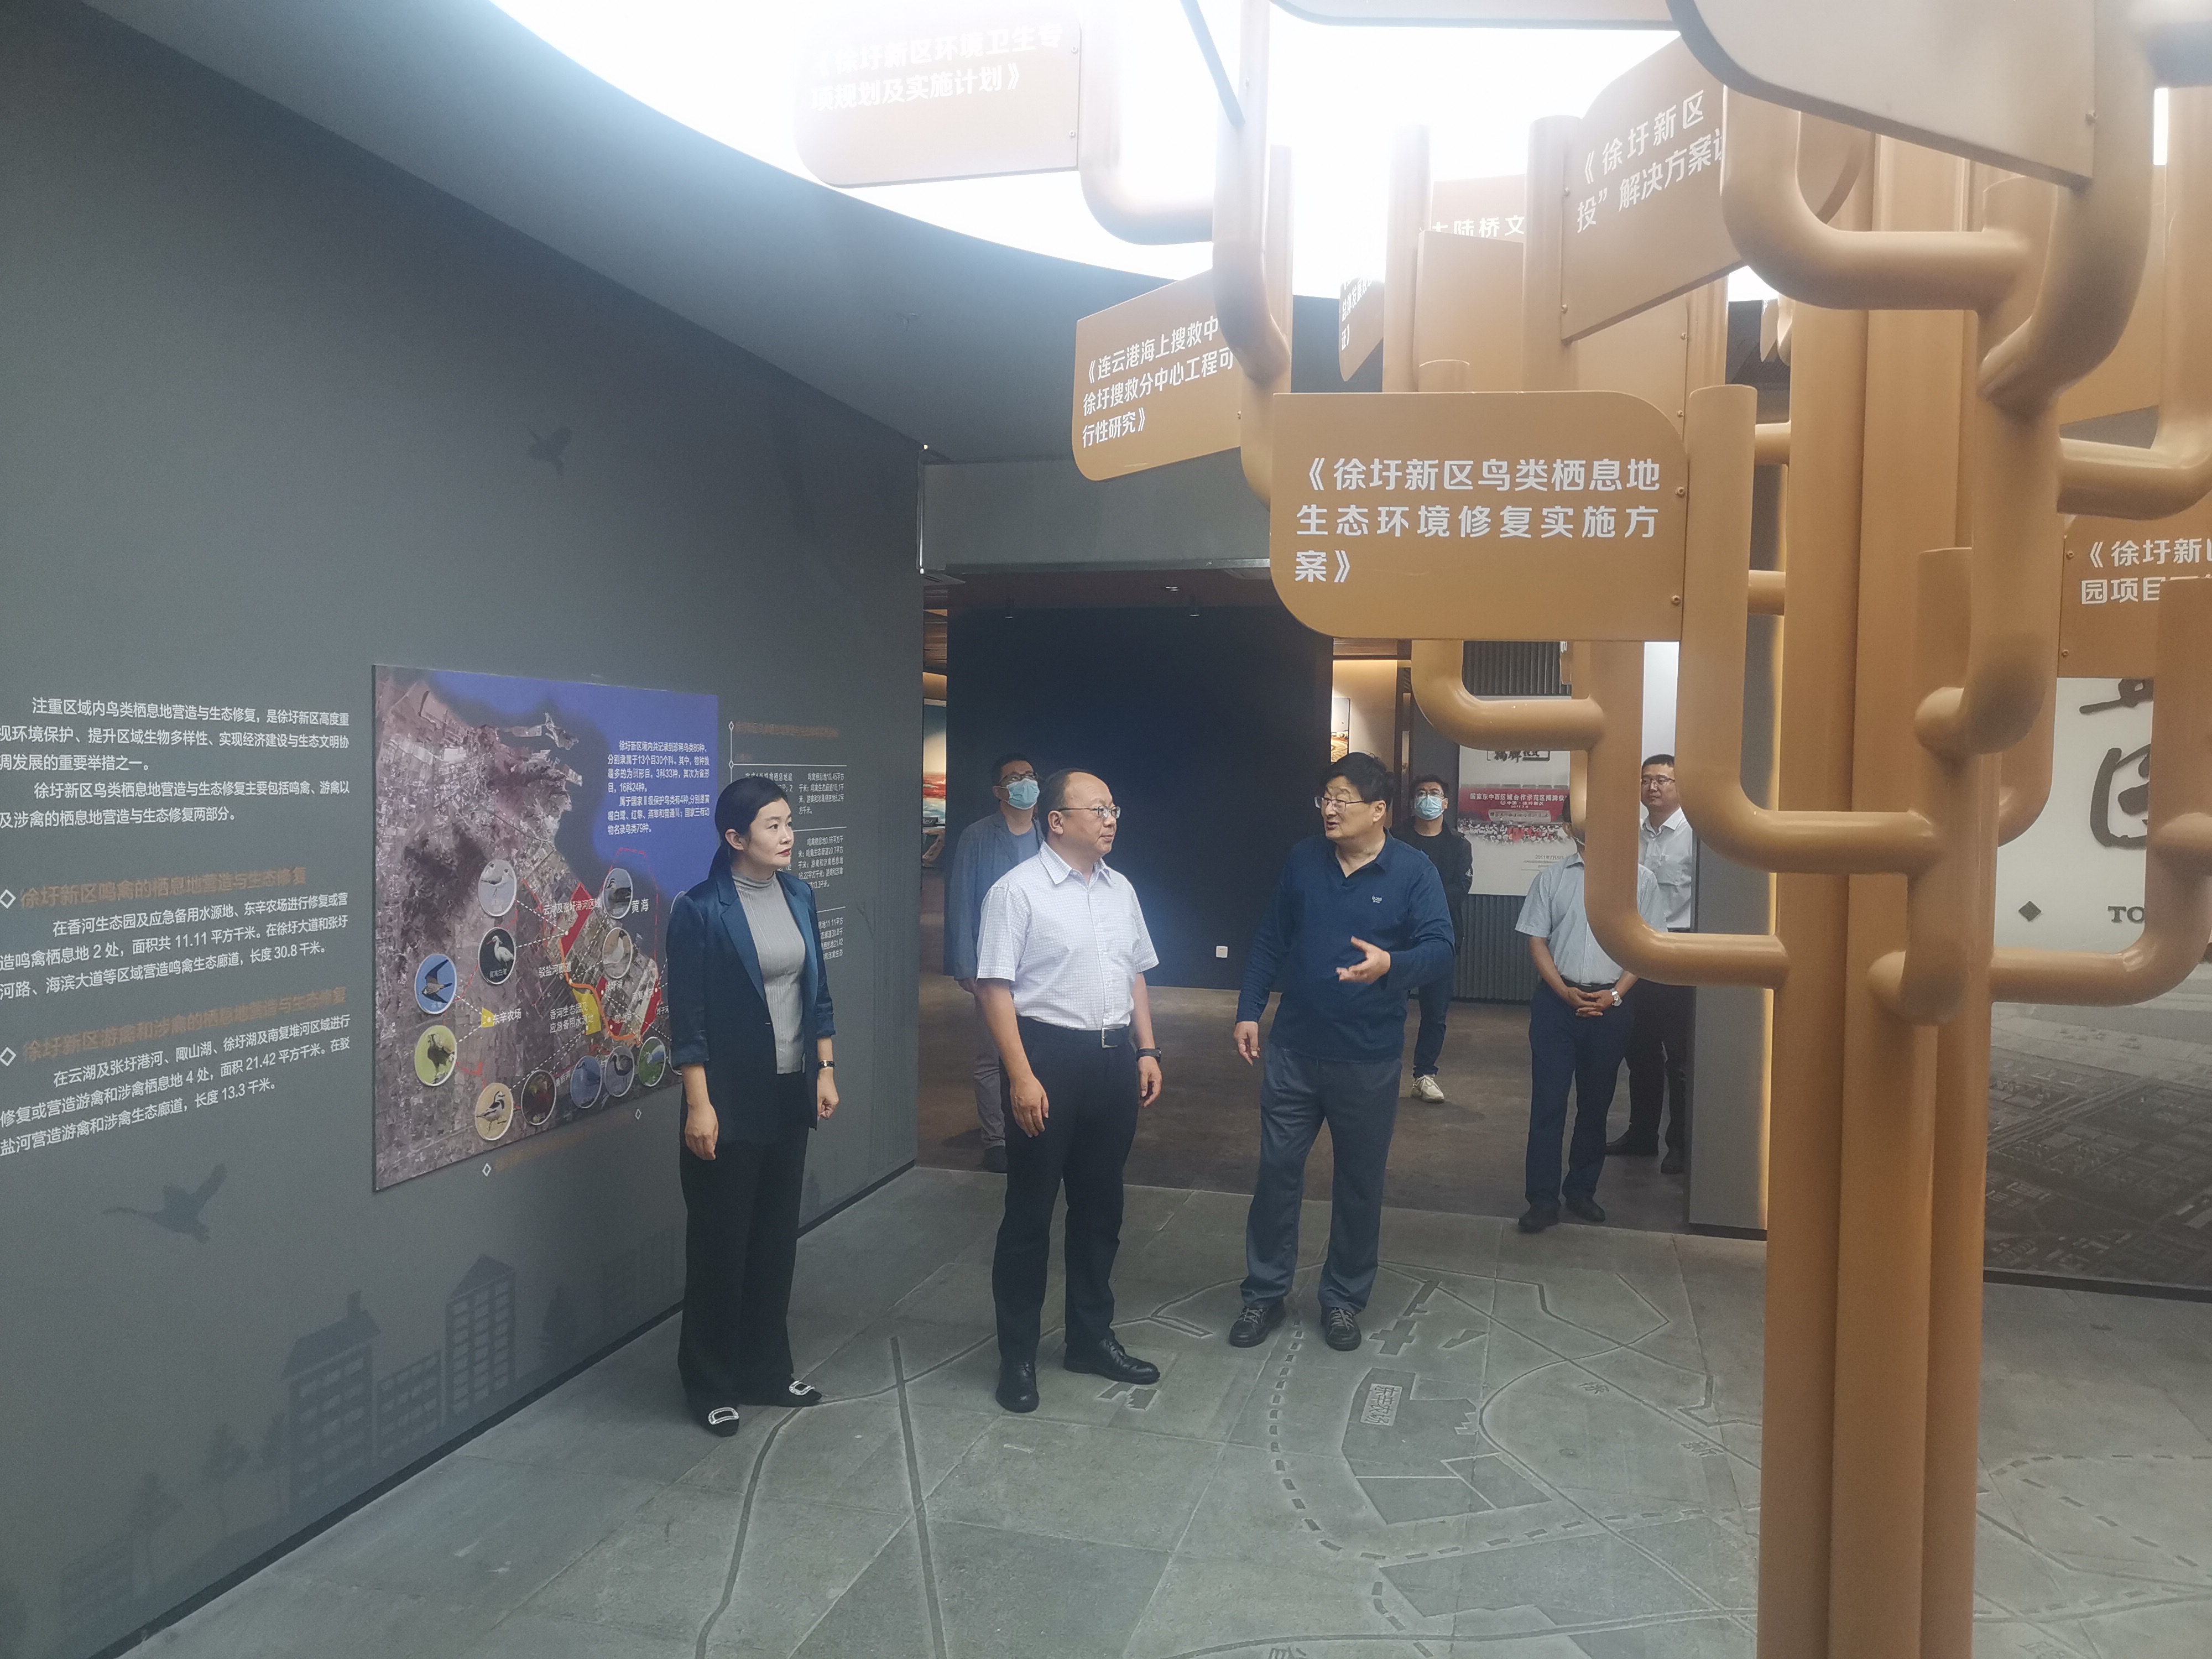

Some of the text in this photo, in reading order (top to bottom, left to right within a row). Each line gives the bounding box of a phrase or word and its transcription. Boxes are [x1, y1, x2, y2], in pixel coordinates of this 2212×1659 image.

[815, 23, 1062, 77] 《徐圩新区环境卫生专
[810, 62, 1020, 111] 项规划及实施计划》
[1585, 90, 1704, 184] 《徐圩新区
[1577, 128, 1723, 233] 投”解决方案
[1088, 316, 1218, 384] 《连云港海上搜救中
[1083, 347, 1234, 416] 徐圩搜救分中心工程可
[1082, 407, 1145, 448] 行性研究》
[1308, 457, 1660, 492] 《徐圩新区鸟类栖息地
[1296, 504, 1658, 539] 生态环境修复实施方
[1295, 550, 1350, 583] 案》
[2090, 538, 2212, 568] 《徐圩新
[2081, 577, 2163, 604] 园项目
[32, 697, 349, 726] 注重区域内鸟类栖息地营造与生态修复，是徐圩新区高度重
[34, 780, 350, 799] 徐圩新区鸟类栖息地营造与生态修复主要包括鸣禽、游禽以
[1470, 792, 1568, 802] 国家东中西区域合作示范区揭牌仪
[0, 806, 235, 829] 及涉禽的栖息地营造与生态修复两部分。
[53, 892, 348, 937] 在香河生态园及应急备用水源地、东辛农场进行修复或营
[632, 898, 649, 914] 黄海
[2107, 906, 2145, 923] TO
[493, 1008, 521, 1025] 东辛农场
[1365, 1385, 1400, 1424] 东辛农场
